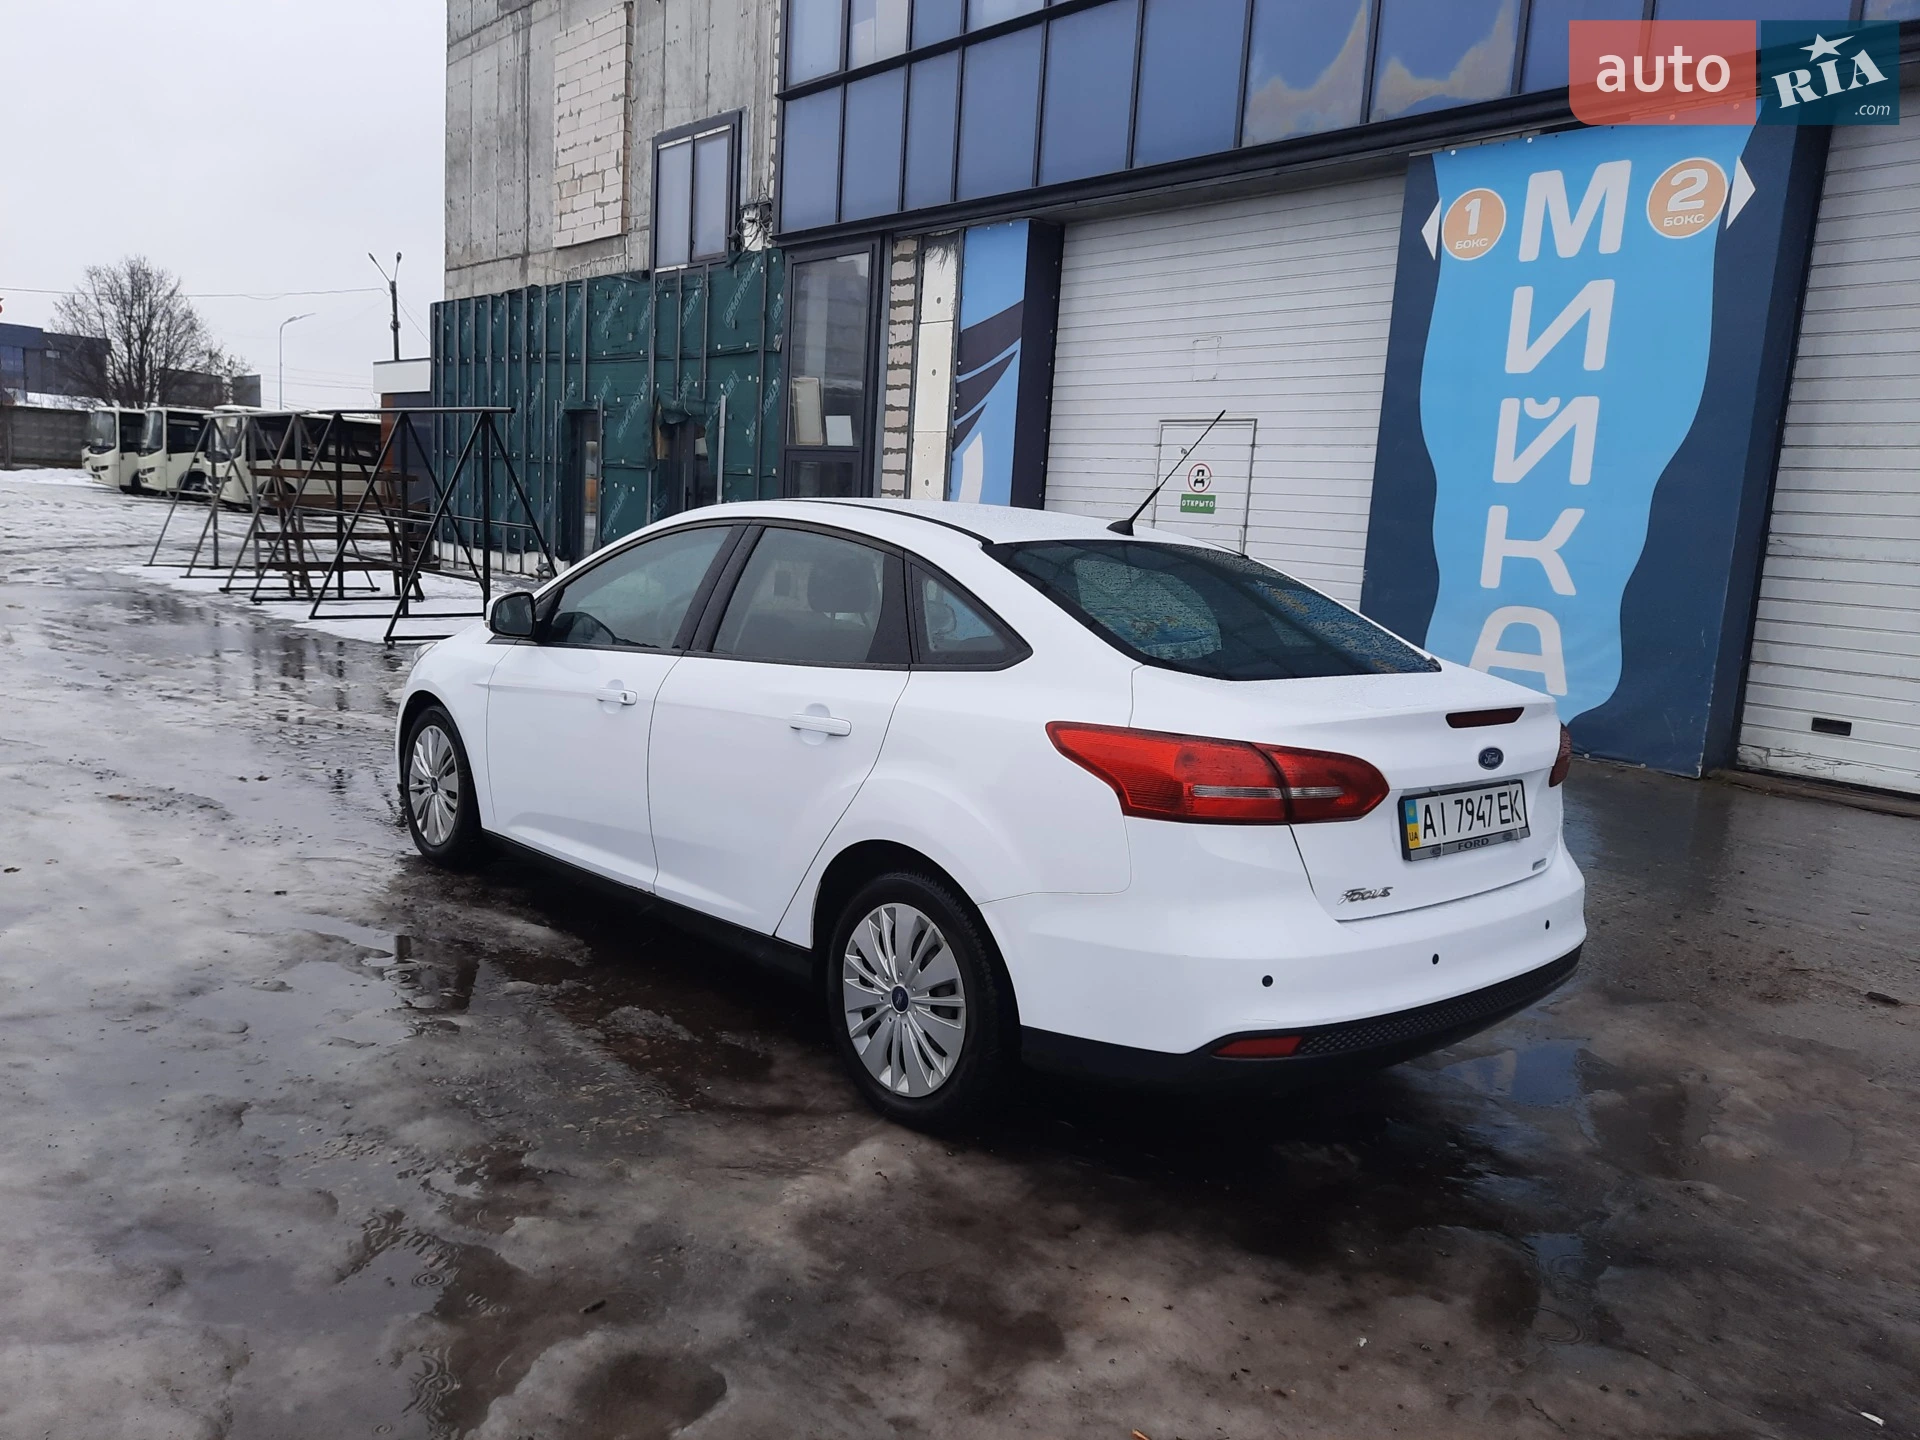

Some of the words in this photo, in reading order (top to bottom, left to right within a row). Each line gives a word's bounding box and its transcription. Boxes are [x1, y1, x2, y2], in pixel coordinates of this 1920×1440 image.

[1667, 168, 1709, 212] 2
[1464, 197, 1482, 236] 1
[1663, 213, 1706, 227] БОКС
[1454, 237, 1489, 250] БОКС
[1469, 159, 1633, 697] МИЙКА
[1181, 499, 1214, 508] ОТКРЫТО
[1423, 802, 1447, 839] AI
[1454, 794, 1494, 833] 7947
[1497, 789, 1522, 825] EK
[1409, 831, 1419, 842] UA
[1457, 837, 1490, 851] FORD
